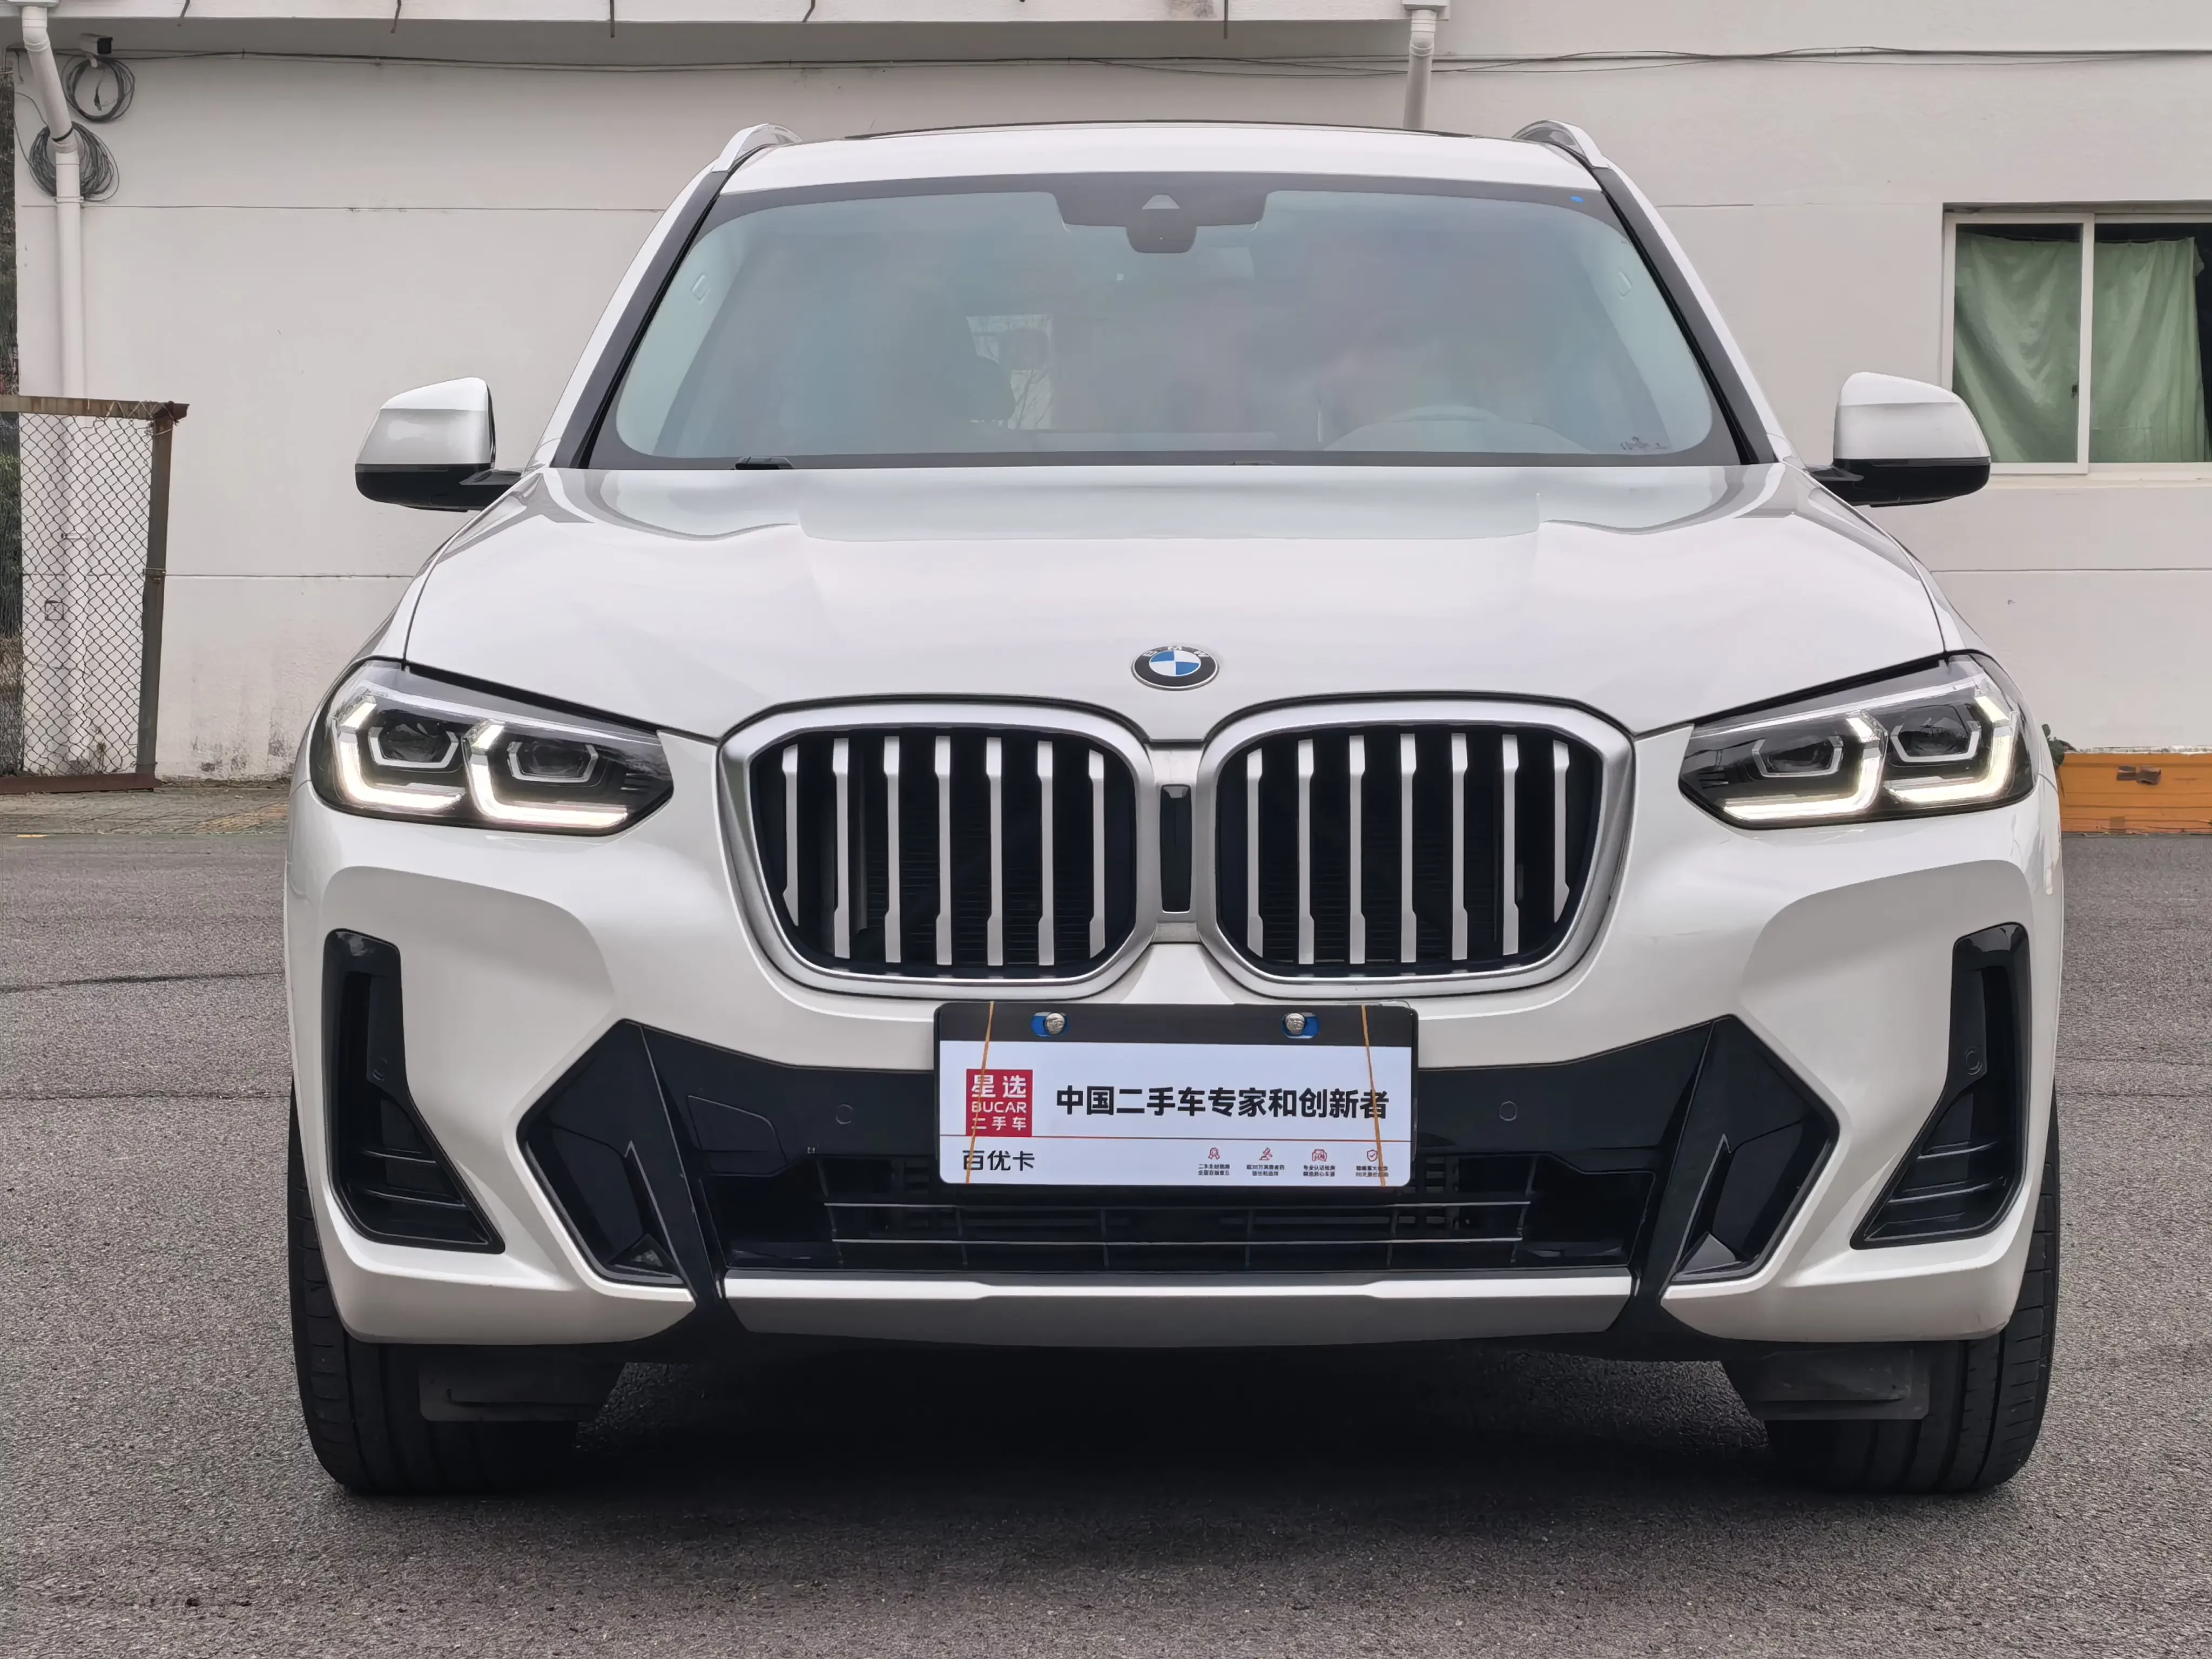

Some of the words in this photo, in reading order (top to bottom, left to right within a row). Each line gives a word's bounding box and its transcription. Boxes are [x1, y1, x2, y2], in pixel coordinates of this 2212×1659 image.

[1142, 645, 1210, 657] BMW
[971, 1075, 1027, 1098] 星选
[972, 1101, 1027, 1113] BUCAR
[1056, 1085, 1390, 1120] 中国二手车专家和创新者
[972, 1116, 1027, 1131] 二手车
[962, 1150, 1035, 1171] 百优卡
